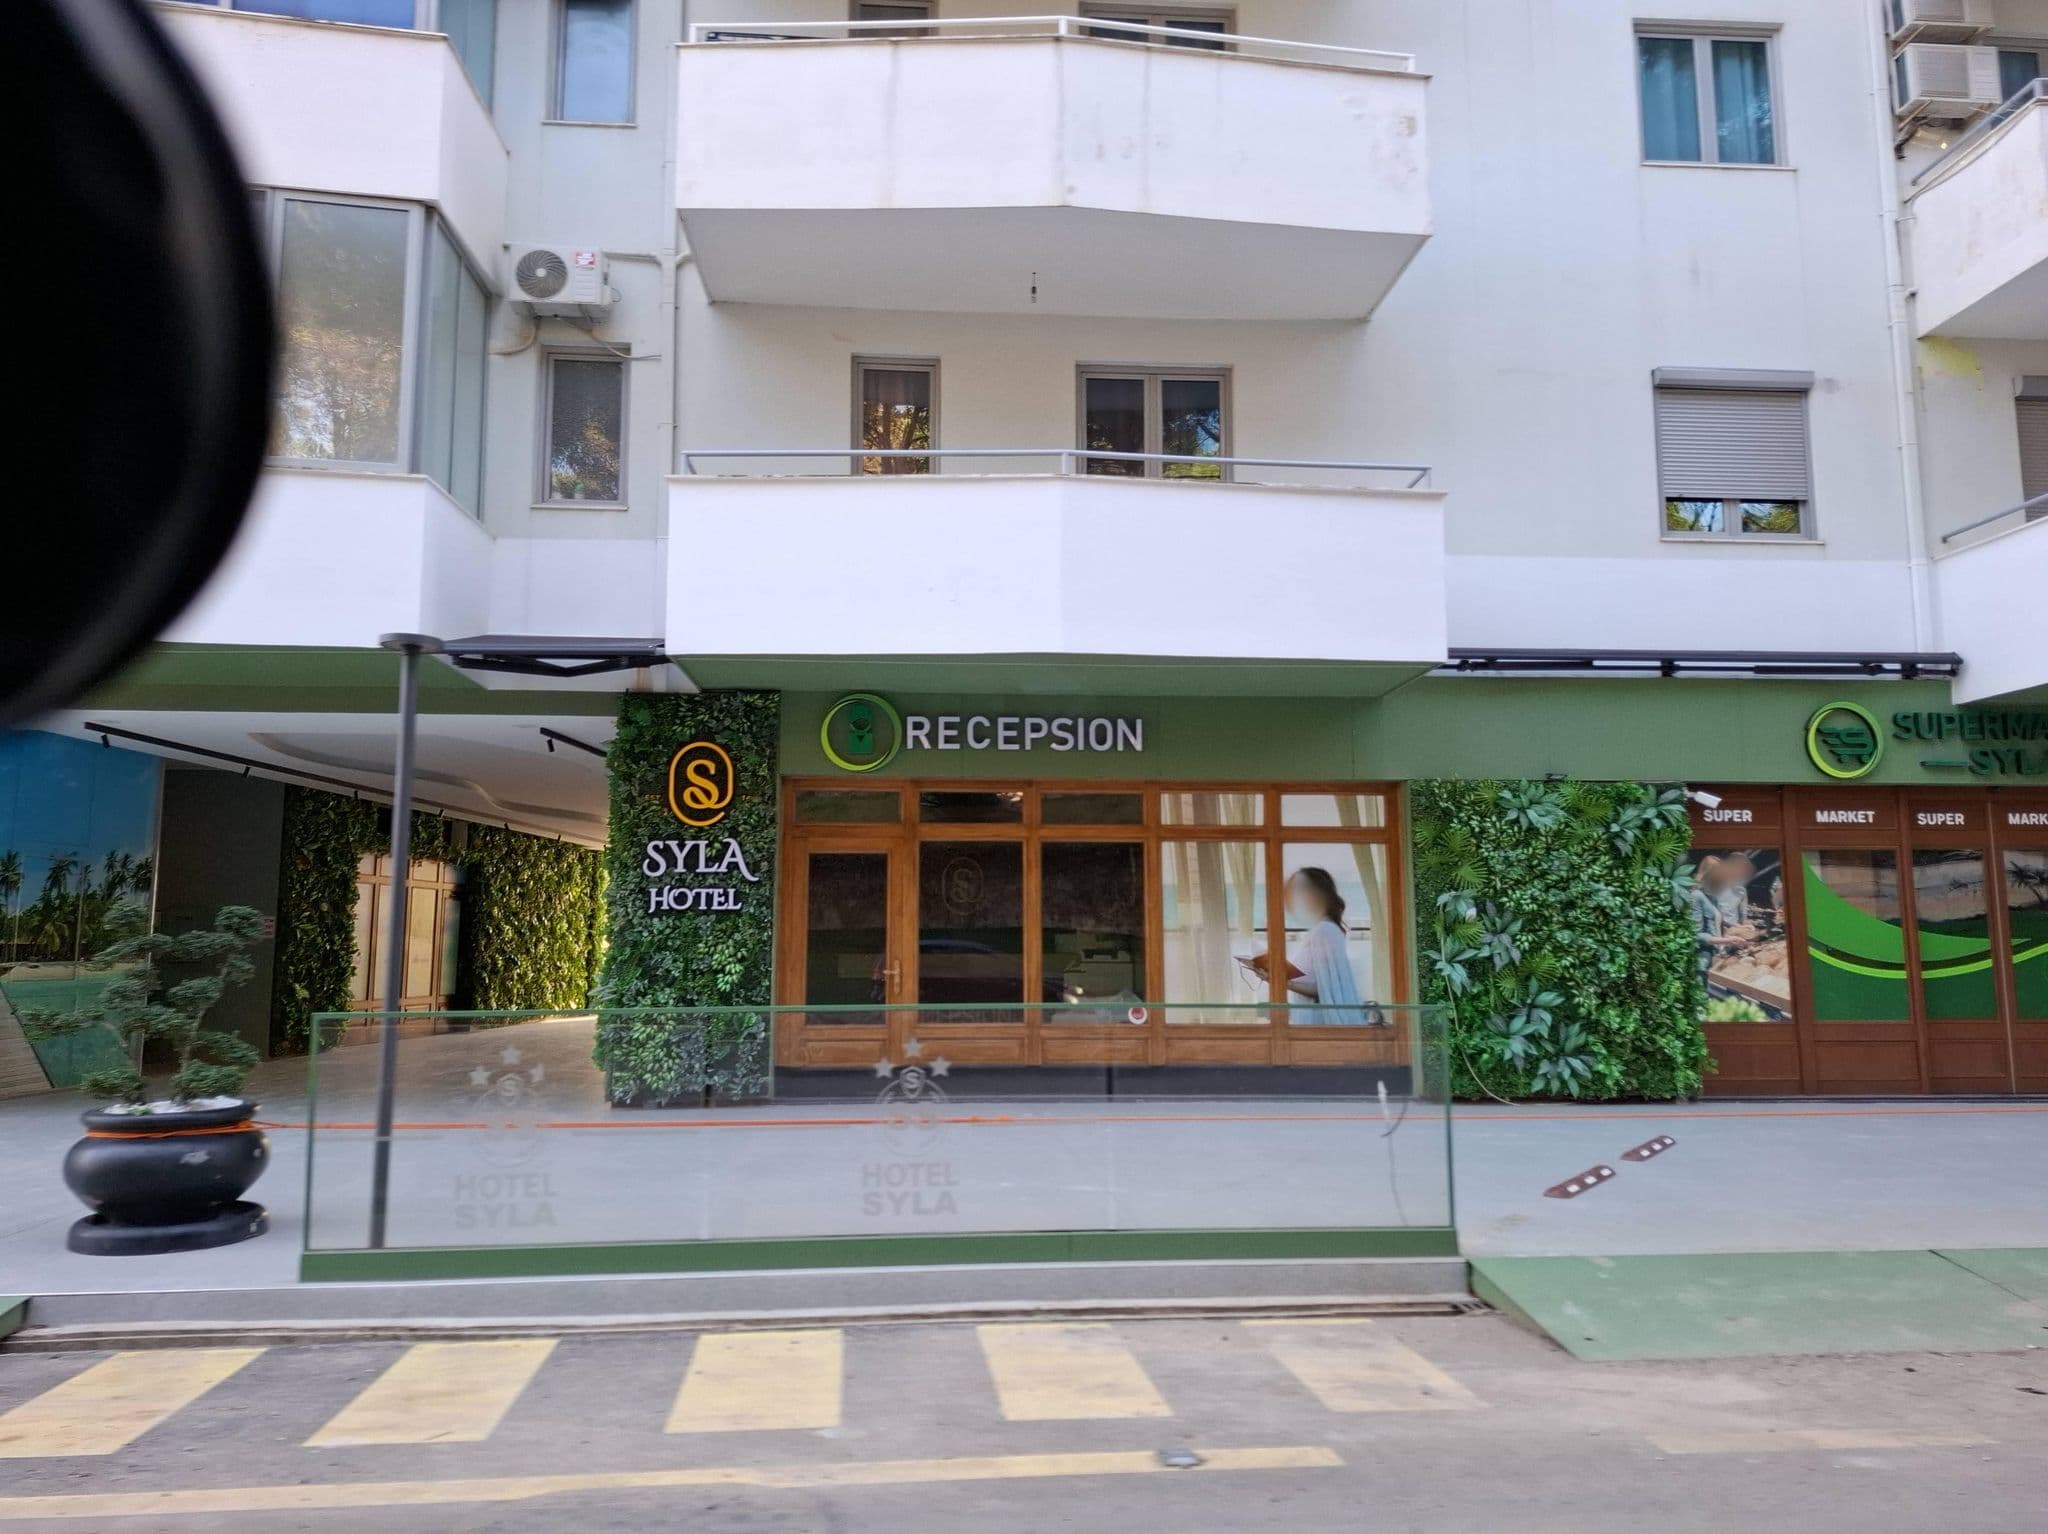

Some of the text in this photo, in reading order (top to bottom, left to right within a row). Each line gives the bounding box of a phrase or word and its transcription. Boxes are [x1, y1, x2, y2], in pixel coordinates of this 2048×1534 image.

[906, 715, 1144, 752] RECEPSION
[1703, 808, 1875, 824] SUPER MARKET
[1917, 812, 1965, 826] SUPER
[642, 838, 760, 882] SYLA
[648, 885, 742, 914] HOTEL
[453, 1173, 559, 1200] HOTEL
[861, 1162, 960, 1188] HOTEL
[454, 1201, 559, 1231] SYLA
[862, 1191, 959, 1217] SYLA
